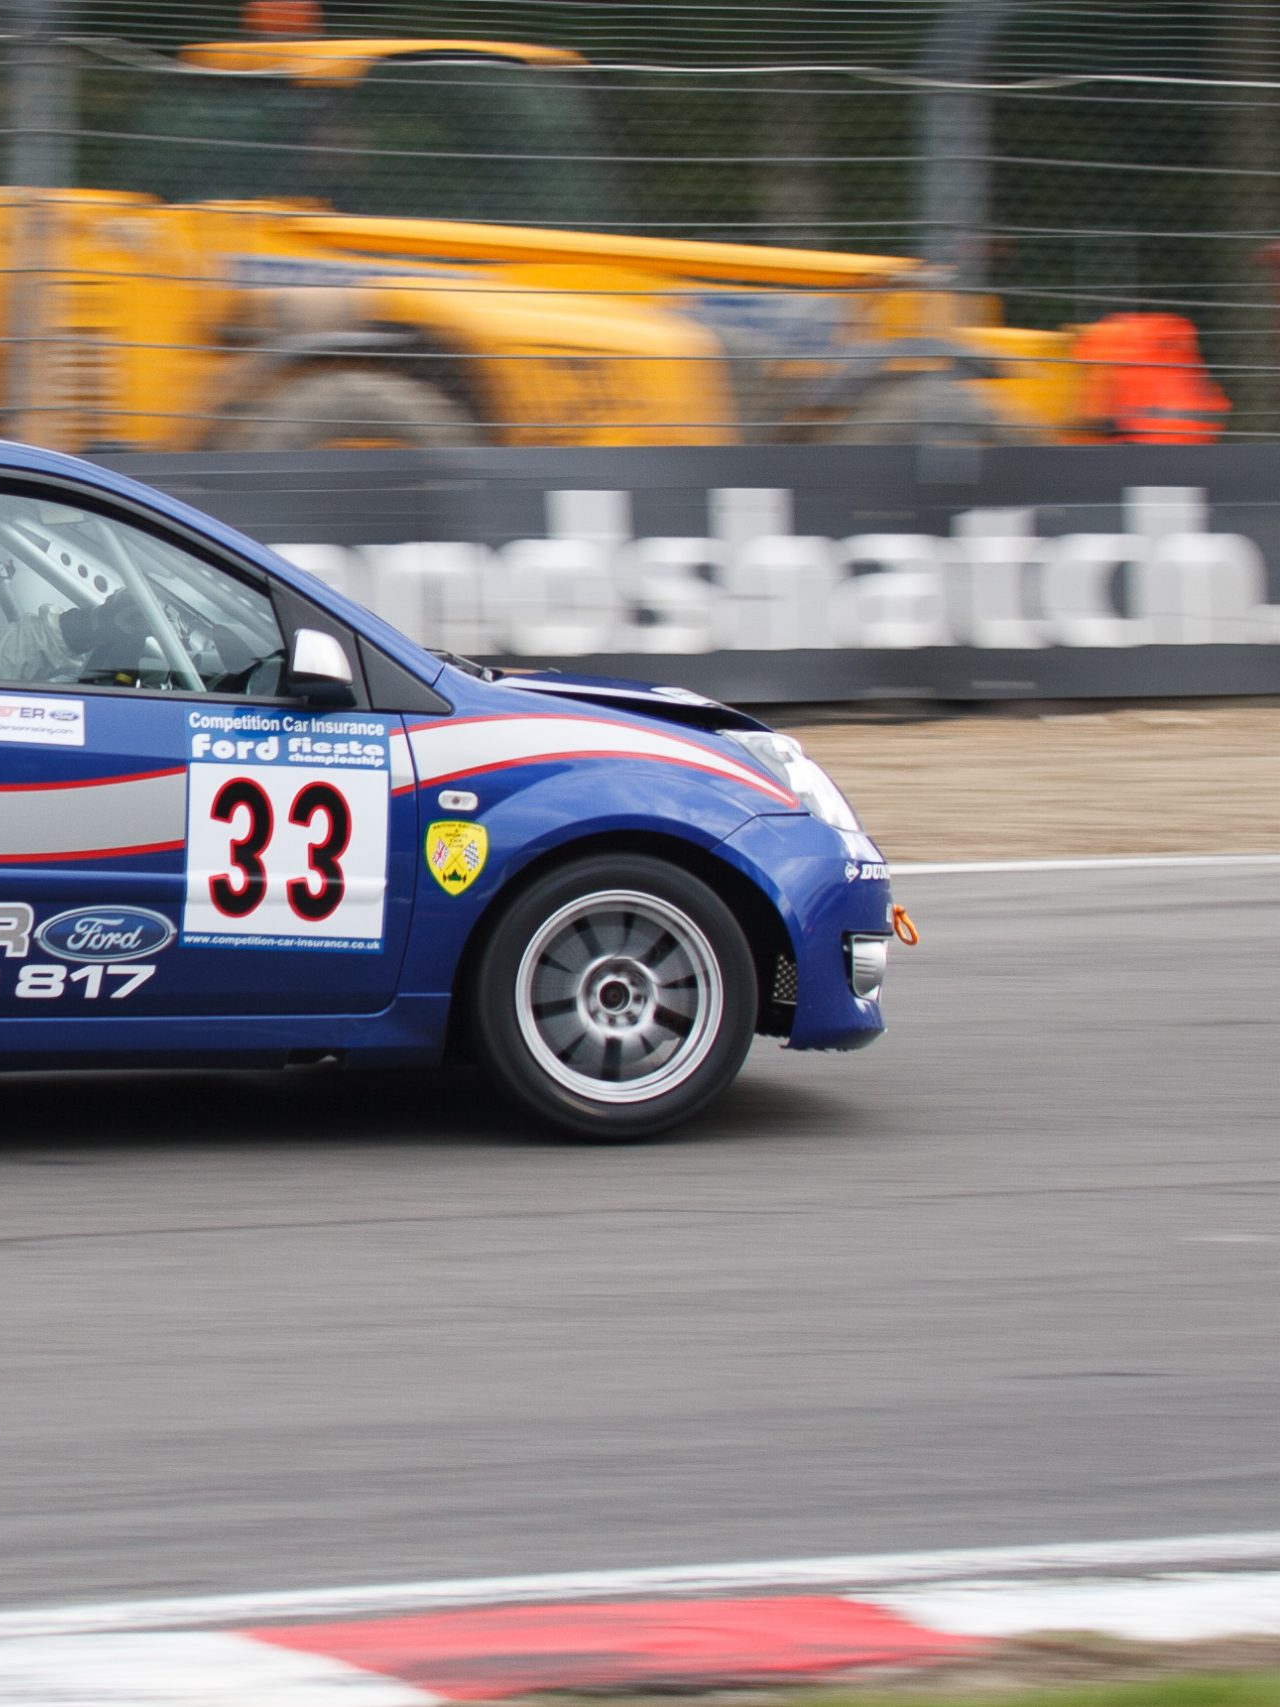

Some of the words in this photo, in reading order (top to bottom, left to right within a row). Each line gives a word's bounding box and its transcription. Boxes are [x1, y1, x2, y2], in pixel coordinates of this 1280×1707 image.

[189, 712, 280, 732] Competition
[282, 716, 309, 732] Car
[311, 719, 385, 736] Insurance
[288, 754, 385, 768] championship
[208, 776, 352, 922] 33
[860, 864, 891, 880] DUN
[183, 934, 380, 950] www.competition-car-insurance.co.uk
[15, 965, 157, 1000] 817
